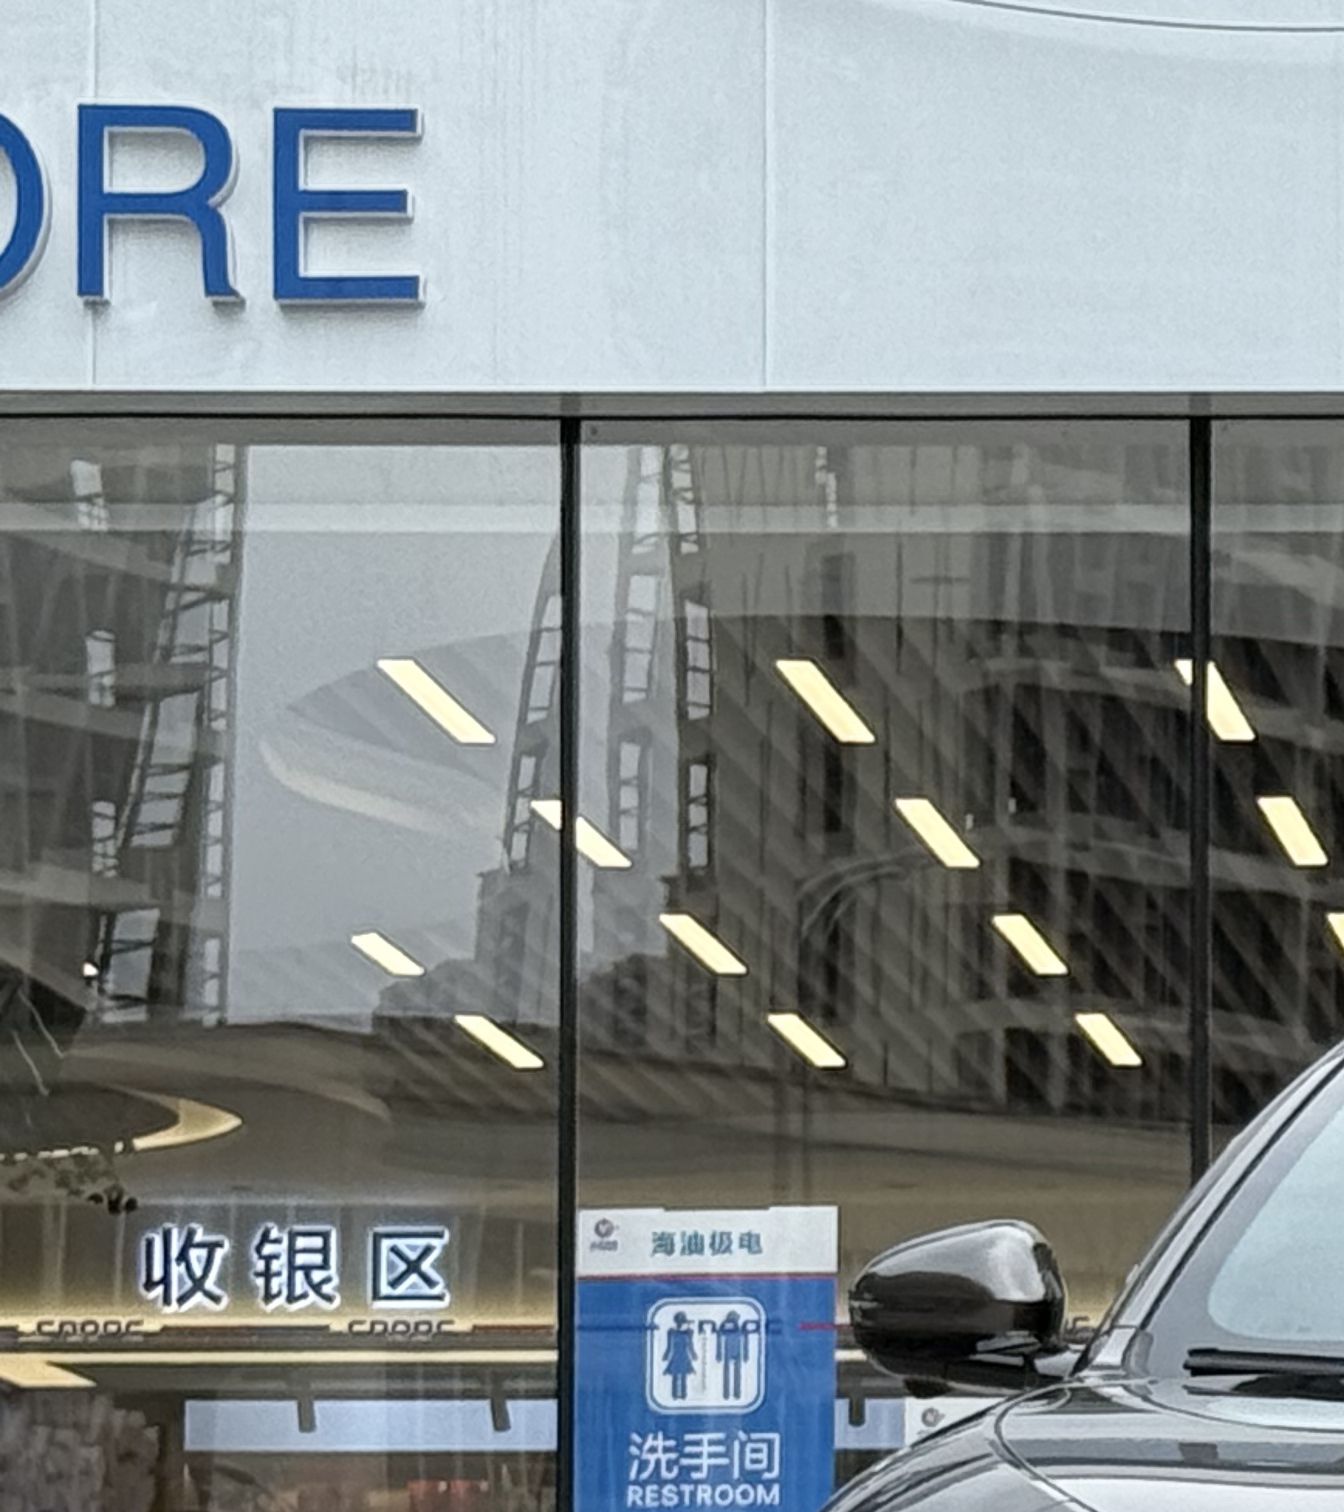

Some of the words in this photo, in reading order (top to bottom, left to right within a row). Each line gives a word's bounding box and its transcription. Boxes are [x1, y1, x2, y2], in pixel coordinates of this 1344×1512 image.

[0, 104, 424, 305] RE
[142, 1224, 449, 1311] 收银区
[629, 1431, 780, 1481] 洗手间
[626, 1484, 780, 1507] RESTROOM
